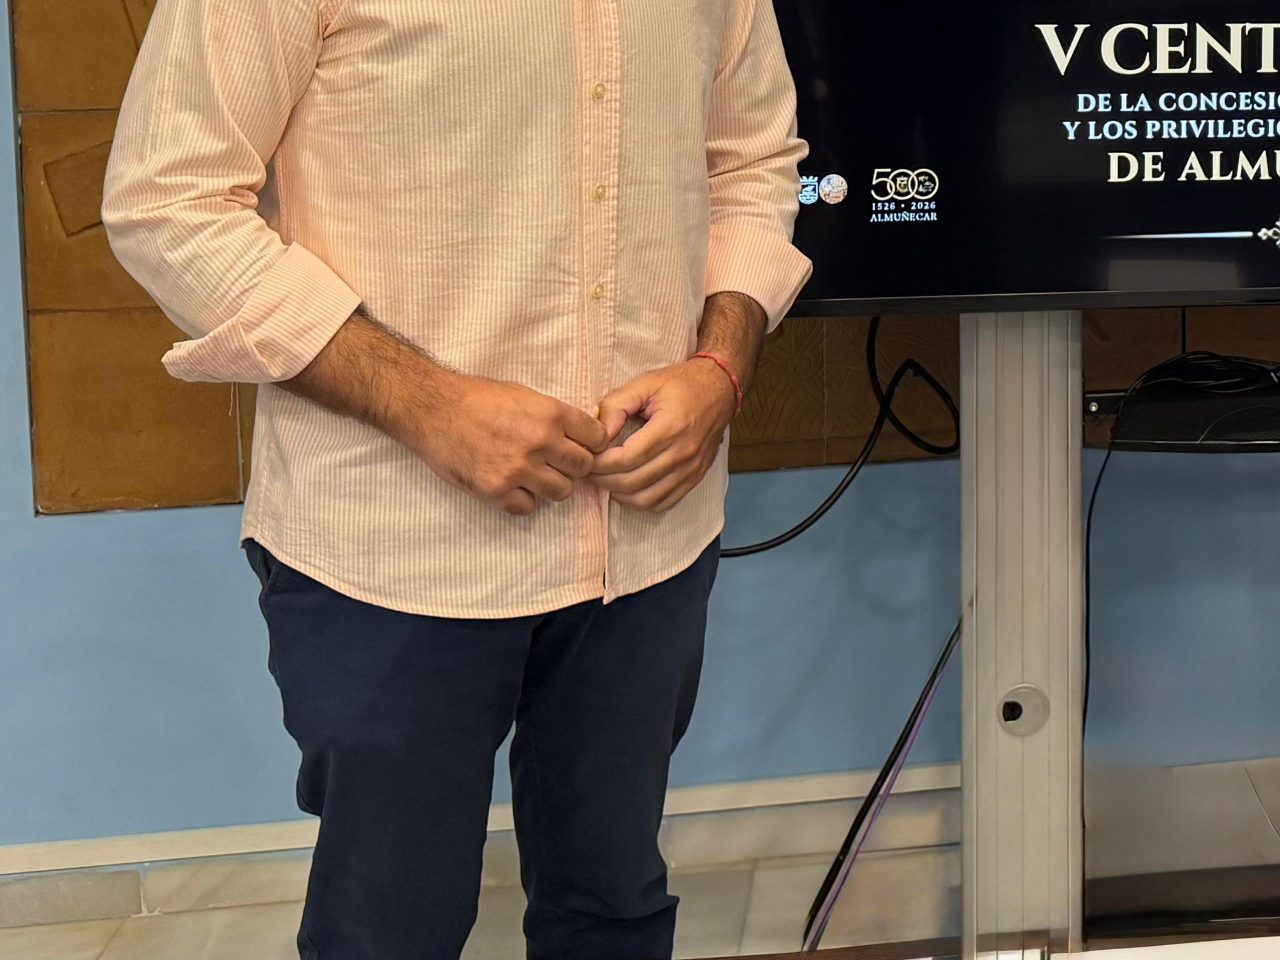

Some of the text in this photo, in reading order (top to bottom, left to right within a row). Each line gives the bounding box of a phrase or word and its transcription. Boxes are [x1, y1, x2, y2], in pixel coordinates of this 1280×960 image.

[1035, 23, 1090, 75] V
[1077, 93, 1111, 112] DE
[1120, 93, 1152, 112] LA
[1063, 121, 1081, 139] Y
[1088, 120, 1137, 139] LOS
[1108, 151, 1165, 183] DE
[872, 201, 936, 211] 1526 2026
